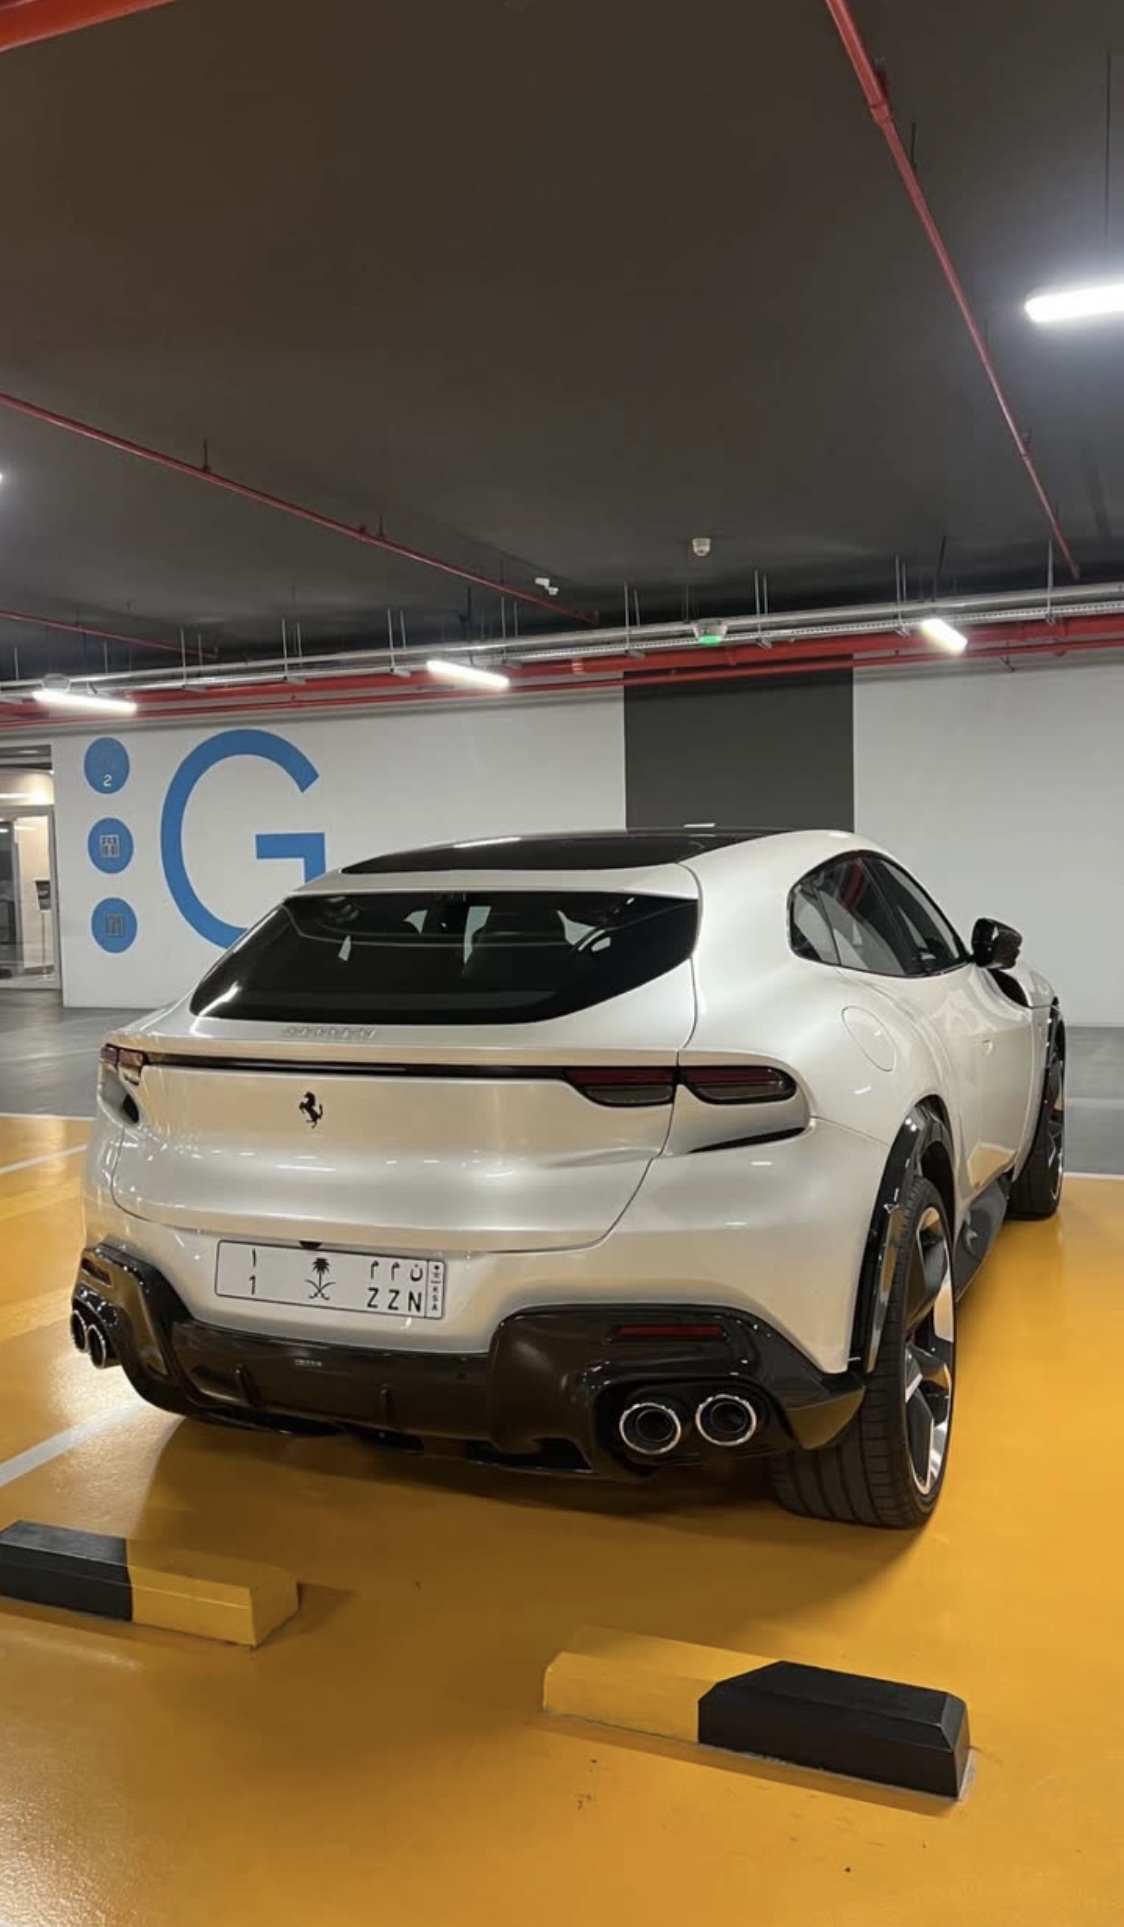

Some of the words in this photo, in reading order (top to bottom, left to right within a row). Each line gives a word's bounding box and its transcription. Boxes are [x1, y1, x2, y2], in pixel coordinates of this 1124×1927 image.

[103, 774, 113, 787] 2
[161, 729, 326, 949] G
[249, 1275, 256, 1295] 1
